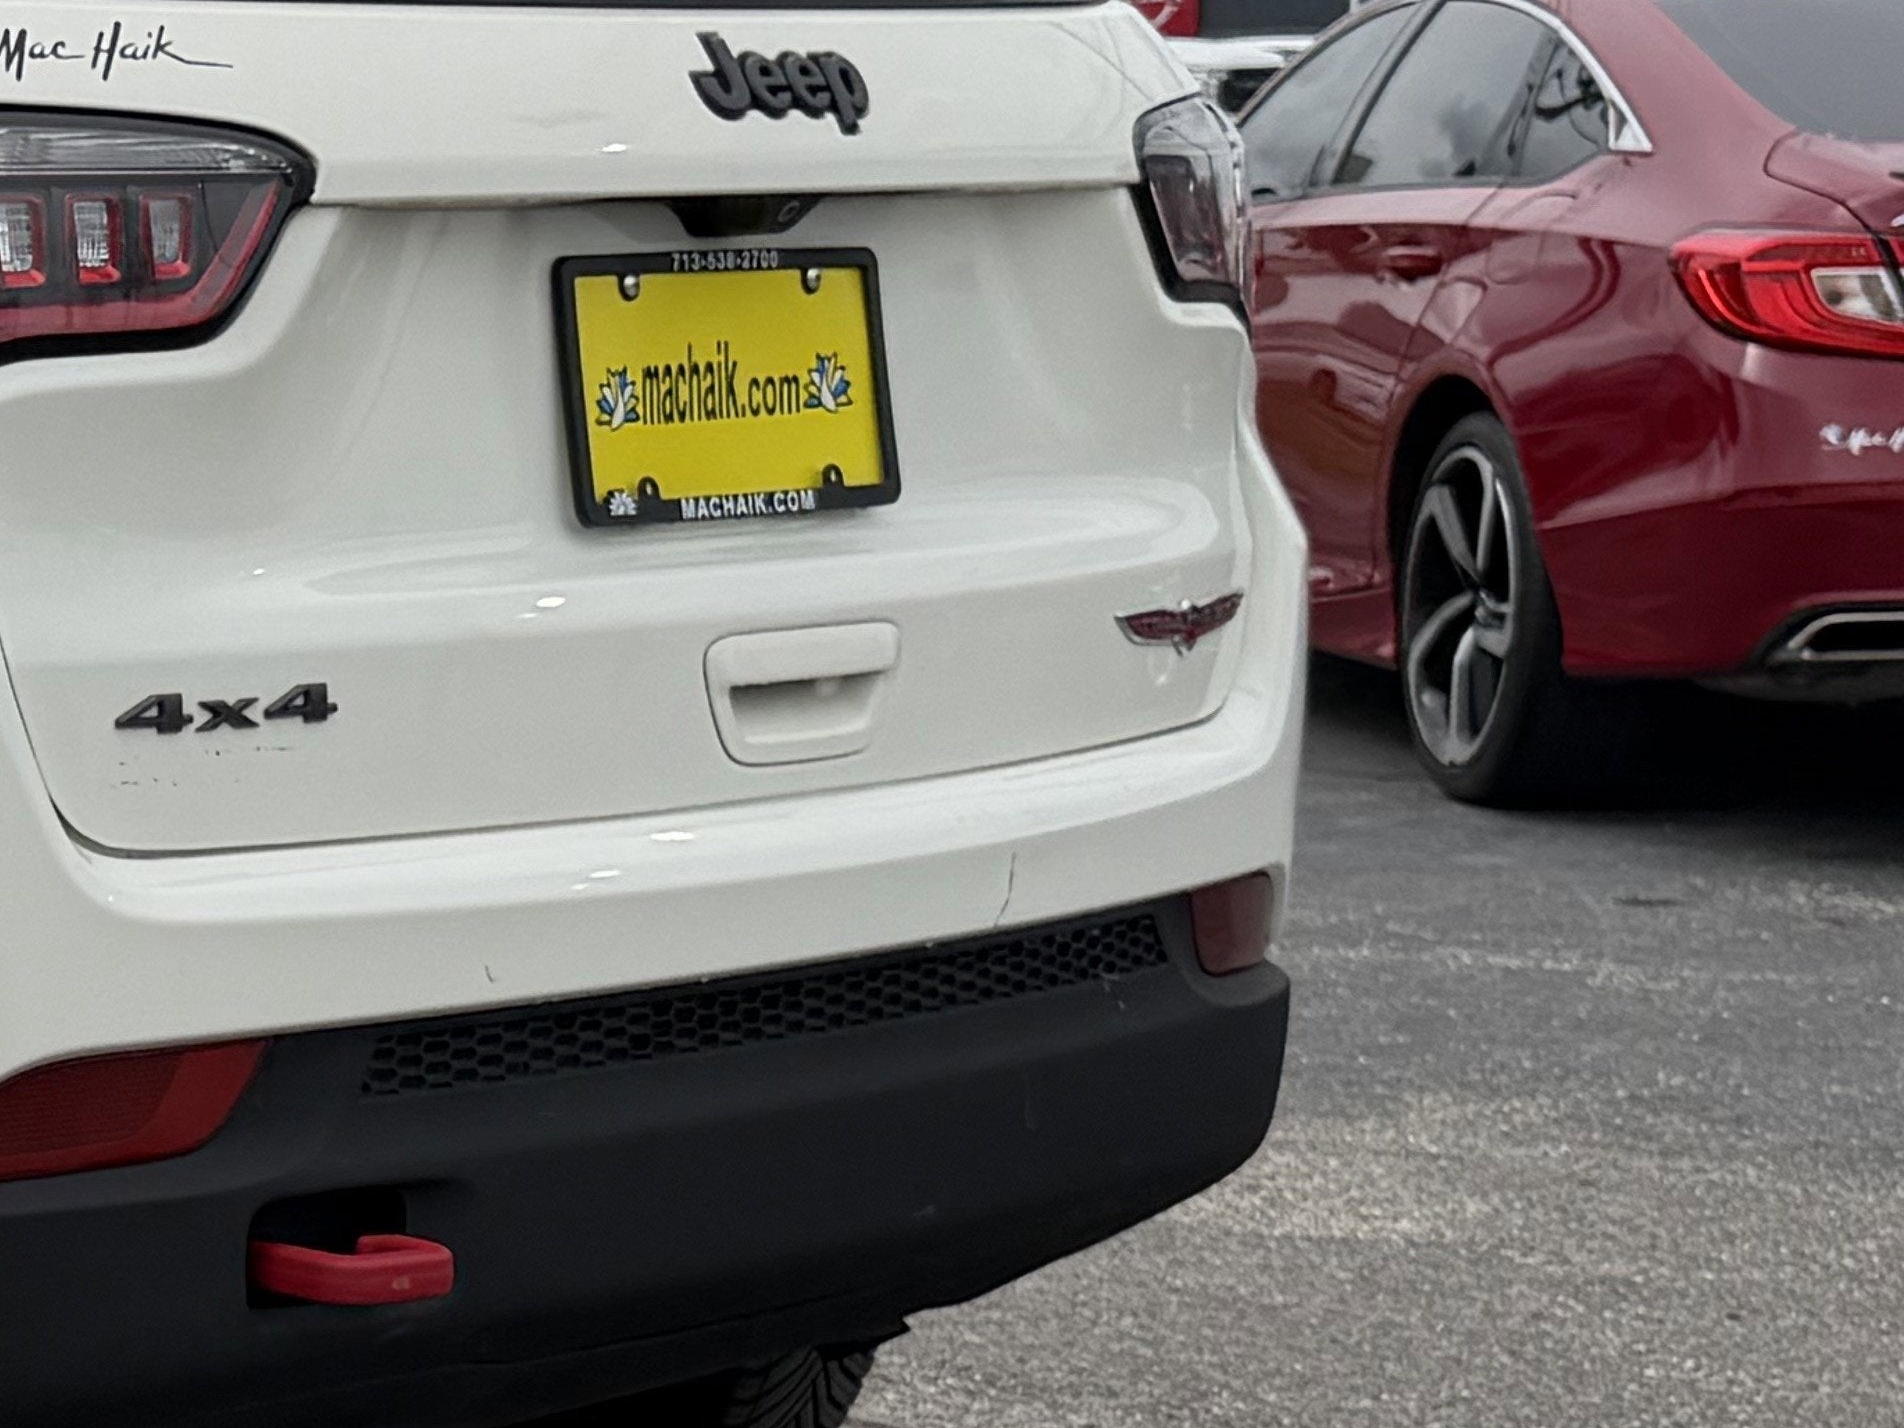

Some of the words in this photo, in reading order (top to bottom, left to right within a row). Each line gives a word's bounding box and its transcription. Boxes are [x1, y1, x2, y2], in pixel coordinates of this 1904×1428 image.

[90, 20, 235, 81] Haik
[689, 31, 870, 136] Jeep
[642, 340, 801, 425] machaik.com
[680, 489, 816, 520] MACHAIK.COM
[114, 682, 338, 735] 4x4
